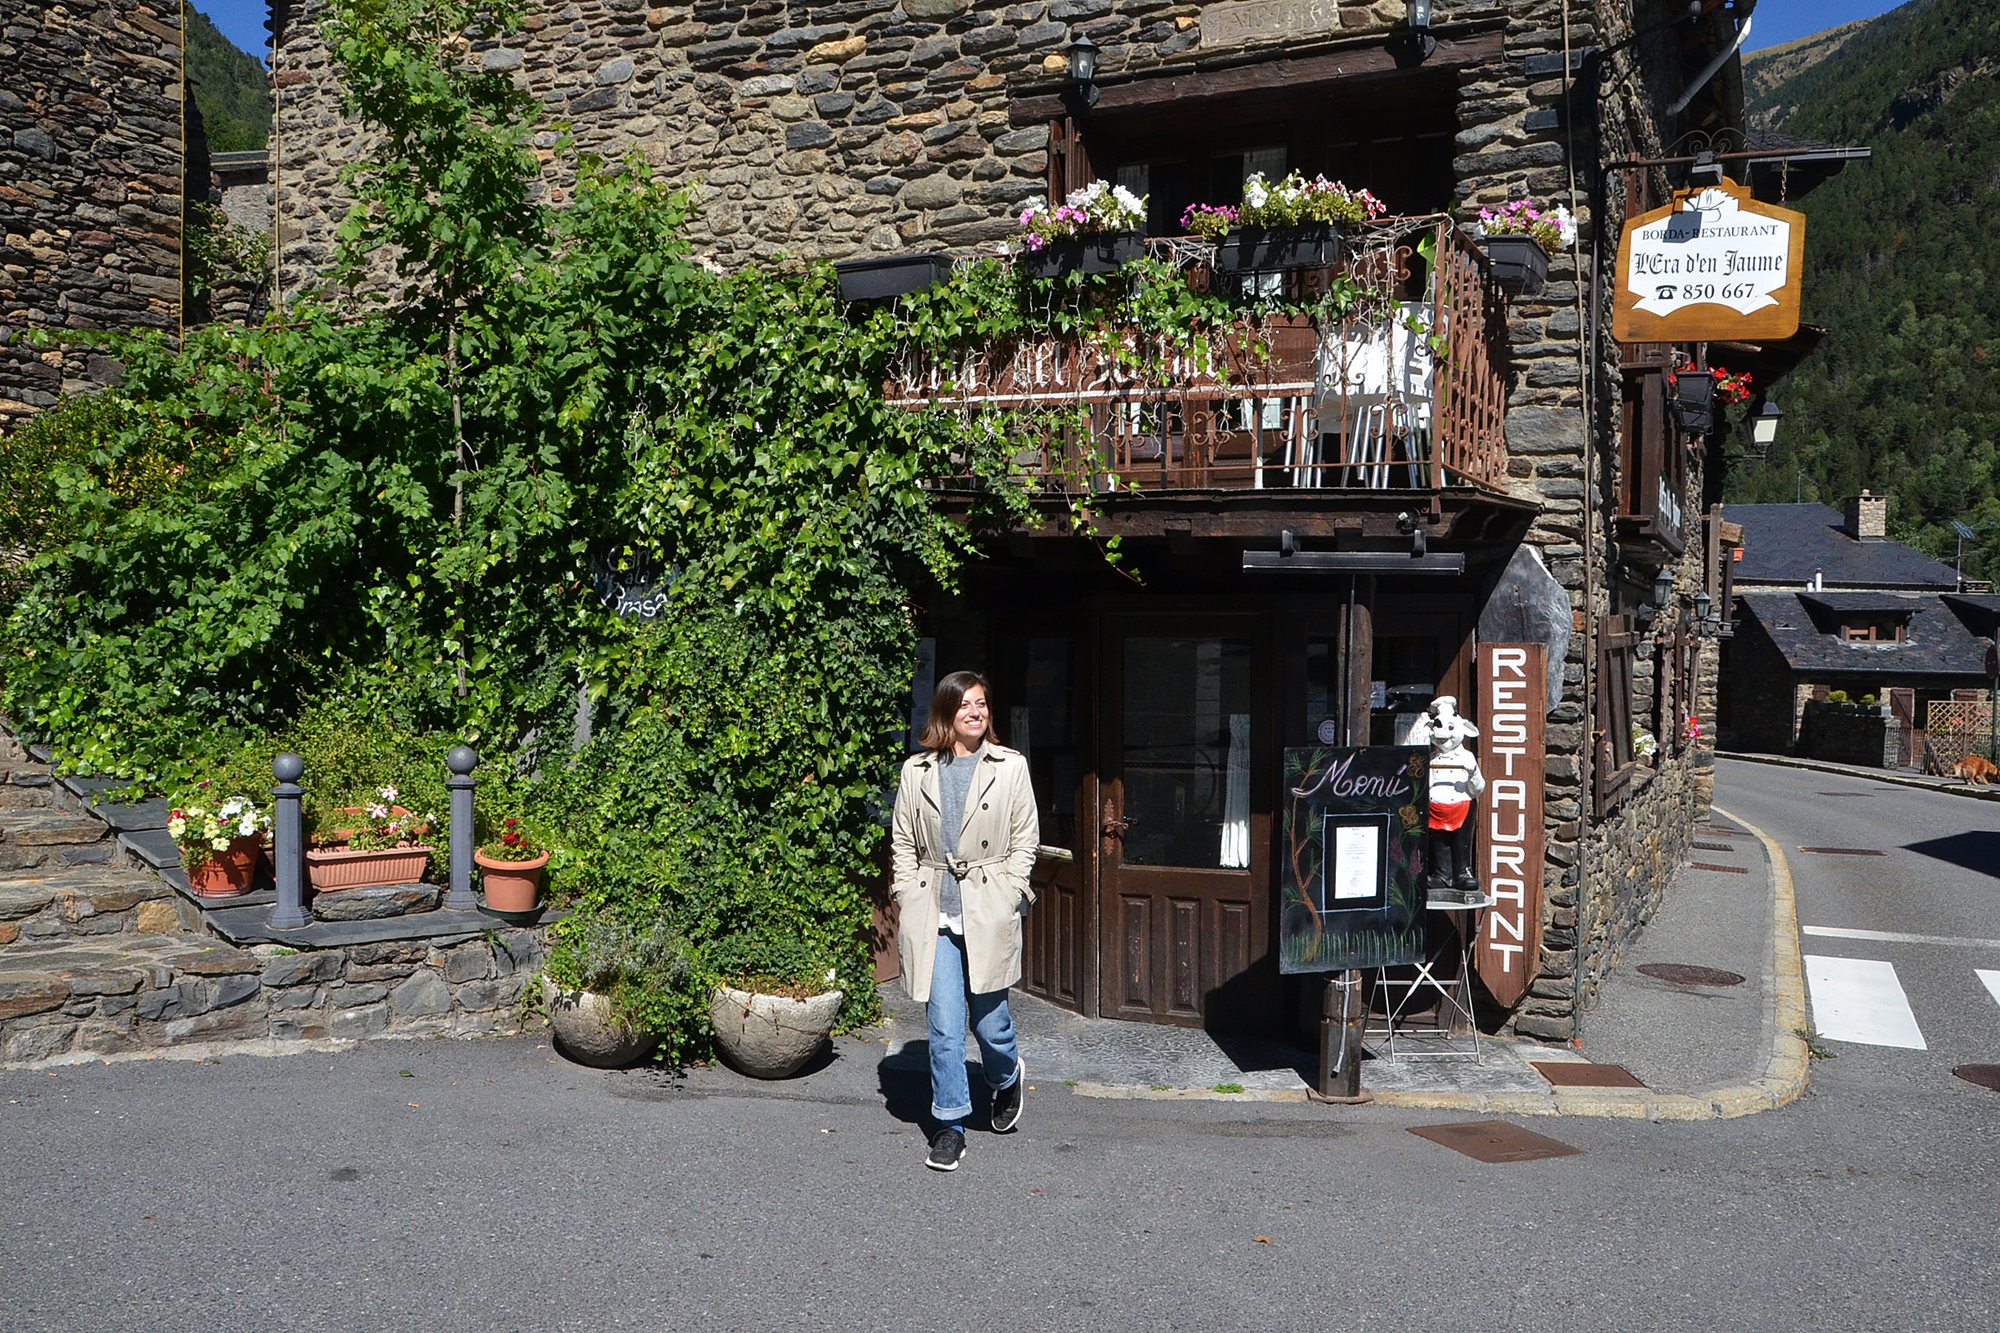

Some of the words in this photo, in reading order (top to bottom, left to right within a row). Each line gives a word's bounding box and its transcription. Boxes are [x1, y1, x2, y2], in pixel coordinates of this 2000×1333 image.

[1634, 252, 1680, 275] L'Era
[1686, 252, 1717, 273] d'en
[1723, 250, 1783, 276] Jaume
[1682, 284, 1715, 299] 850
[1721, 283, 1755, 299] 667
[1291, 752, 1410, 798] Menú
[1490, 648, 1527, 973] RESTAURANT
